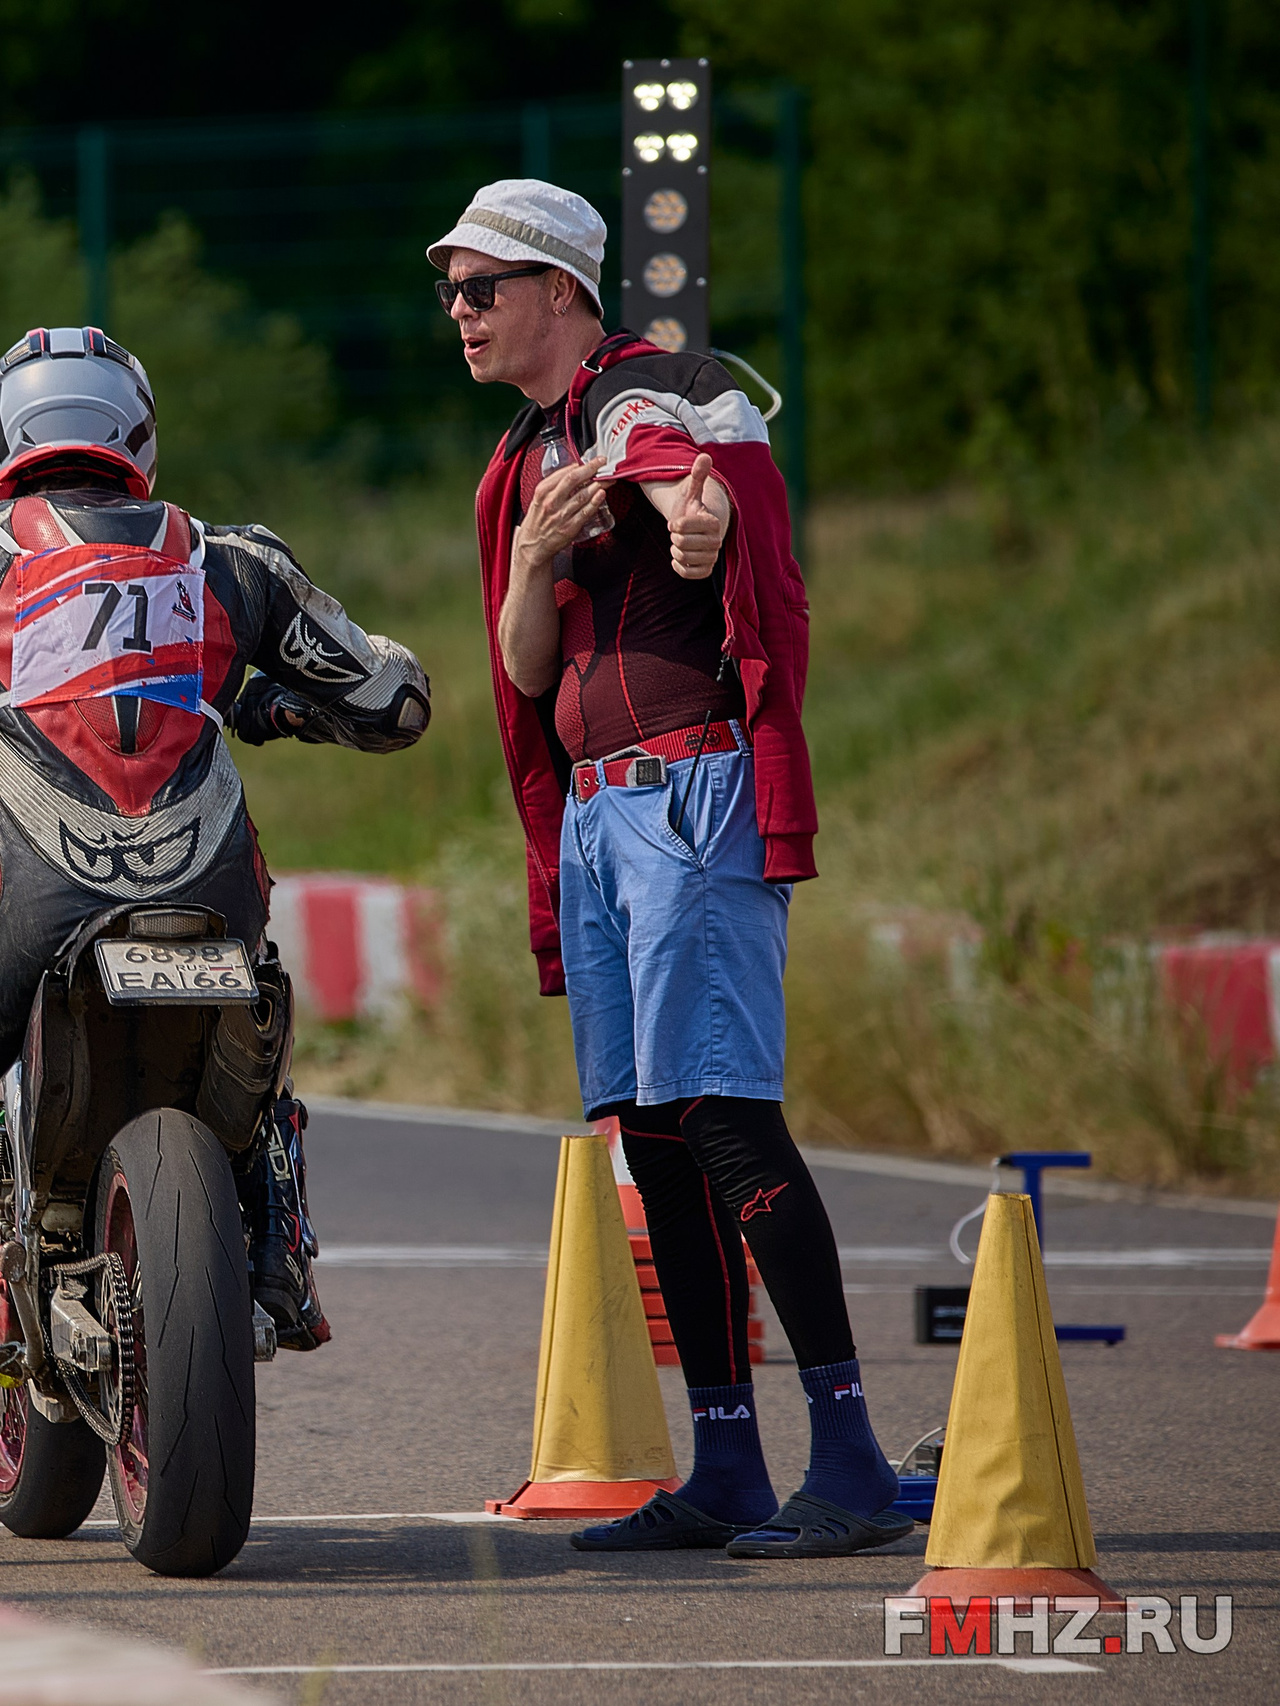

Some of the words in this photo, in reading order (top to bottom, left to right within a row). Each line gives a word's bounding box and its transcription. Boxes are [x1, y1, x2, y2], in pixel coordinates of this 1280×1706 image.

[611, 397, 656, 443] tarks
[82, 582, 152, 653] 71
[176, 964, 208, 972] RUS
[117, 972, 176, 989] EA
[193, 971, 242, 988] 66
[693, 1404, 751, 1421] FILA
